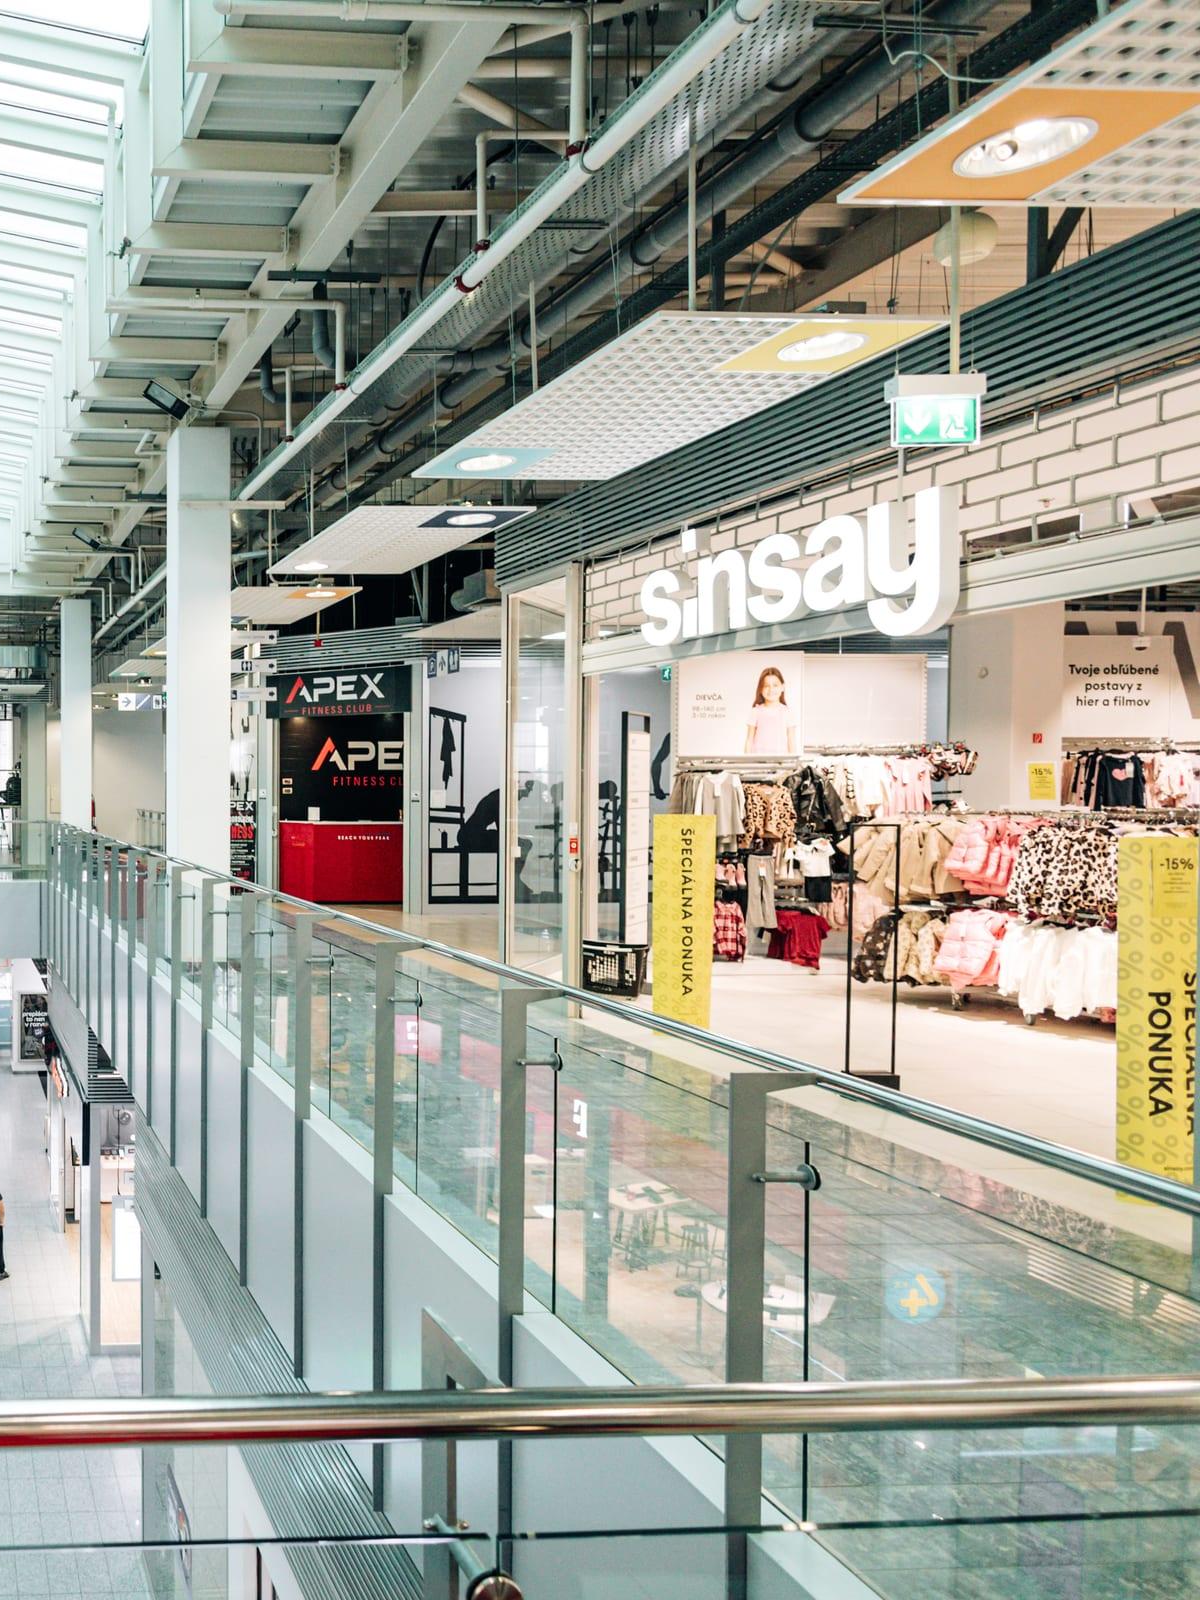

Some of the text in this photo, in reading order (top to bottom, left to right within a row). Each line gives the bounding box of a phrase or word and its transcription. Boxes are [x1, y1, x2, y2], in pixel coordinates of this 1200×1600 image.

[640, 486, 942, 647] sinsay
[1069, 664, 1100, 677] Tvoje
[285, 672, 385, 704] APEX
[1085, 681, 1142, 693] postavy z
[1076, 696, 1150, 706] hier a filmov
[302, 704, 372, 715] FITNESS CLUB
[311, 736, 404, 771] APE
[333, 776, 385, 786] FITNESS
[1160, 857, 1194, 870] -15%
[681, 827, 695, 996] ŠPECIÁLNA PONUKA
[1148, 991, 1173, 1117] PONUKA
